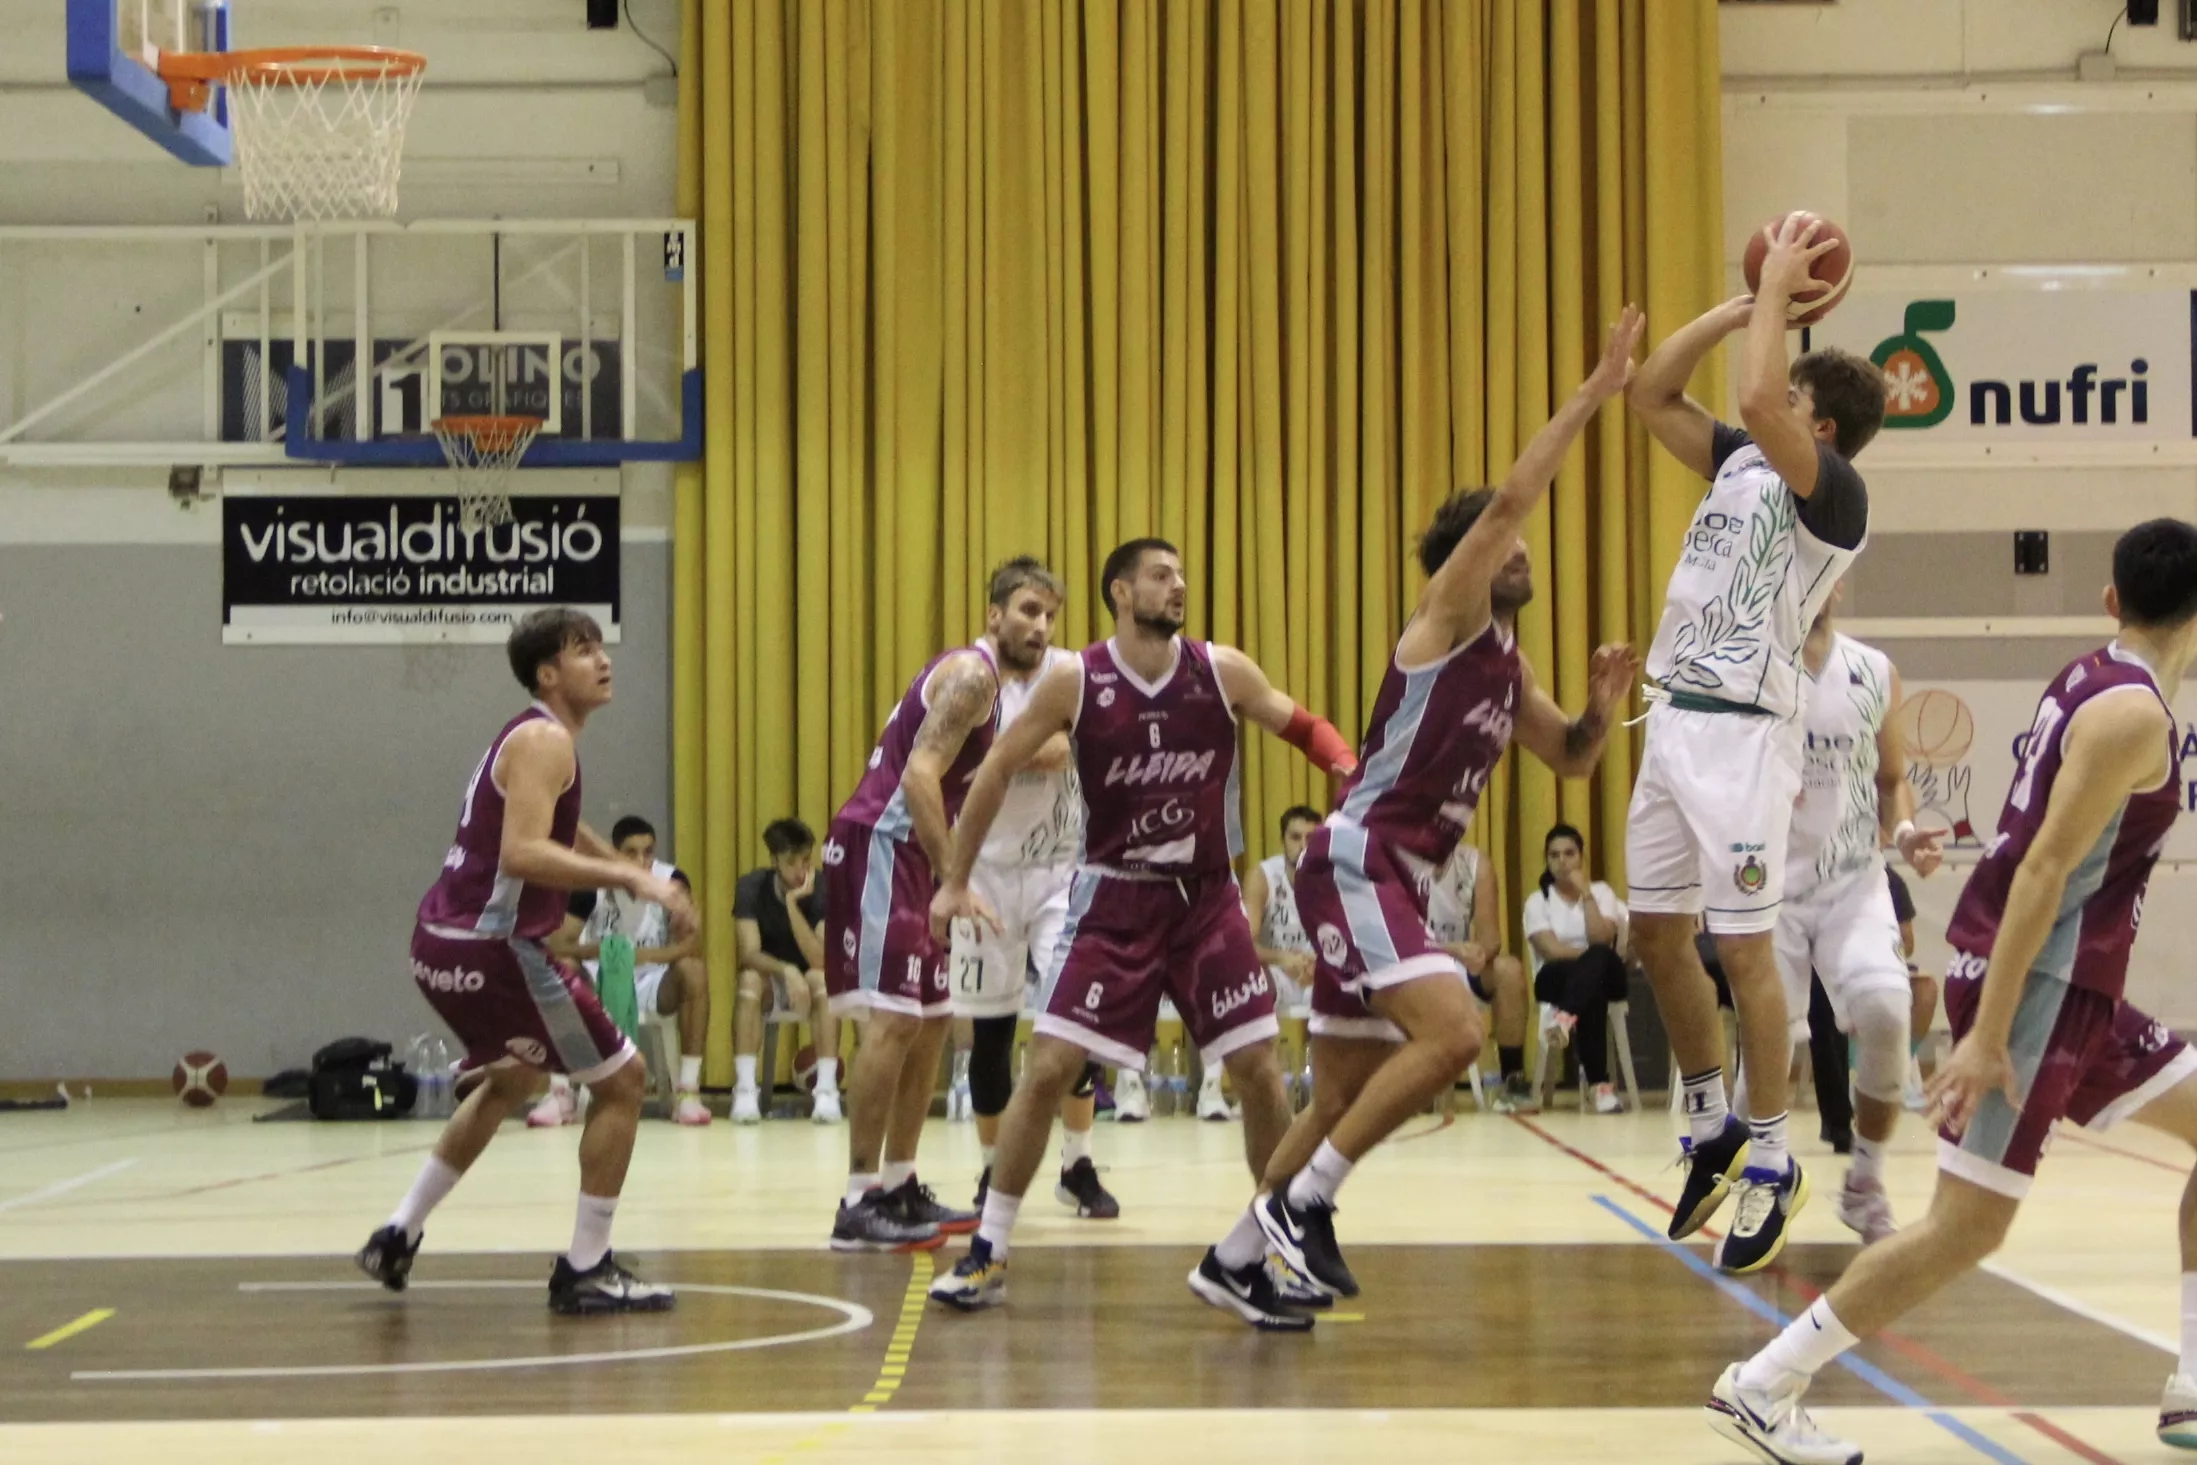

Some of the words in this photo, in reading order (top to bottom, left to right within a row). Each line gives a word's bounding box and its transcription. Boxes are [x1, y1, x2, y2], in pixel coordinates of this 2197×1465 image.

[391, 346, 600, 384] OLINO
[1970, 357, 2148, 425] nufri
[290, 566, 411, 596] retolació
[419, 564, 555, 596] industrial
[961, 956, 984, 994] 27
